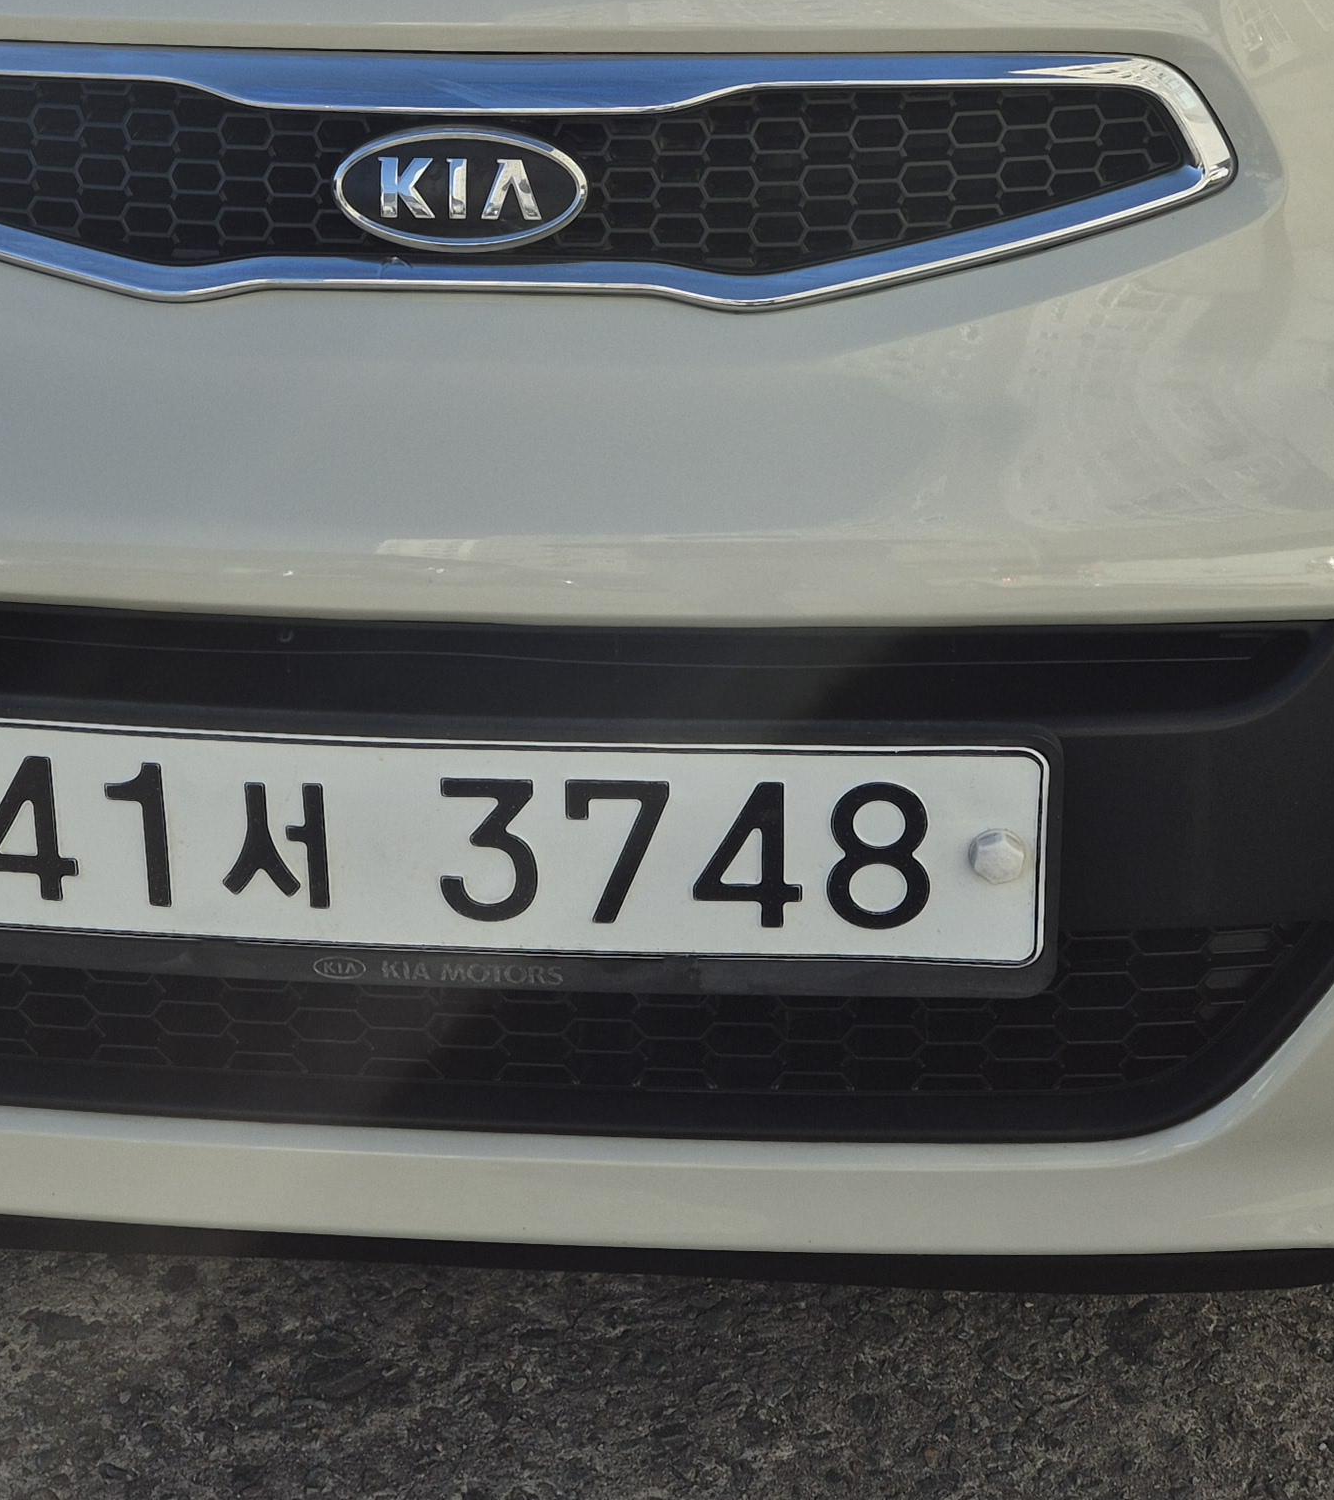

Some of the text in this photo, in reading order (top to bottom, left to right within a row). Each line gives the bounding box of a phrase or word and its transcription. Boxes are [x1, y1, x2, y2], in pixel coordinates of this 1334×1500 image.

[377, 156, 542, 221] KIA
[440, 777, 931, 930] 3748
[381, 959, 431, 982] KIA
[440, 963, 564, 986] MOTORS
